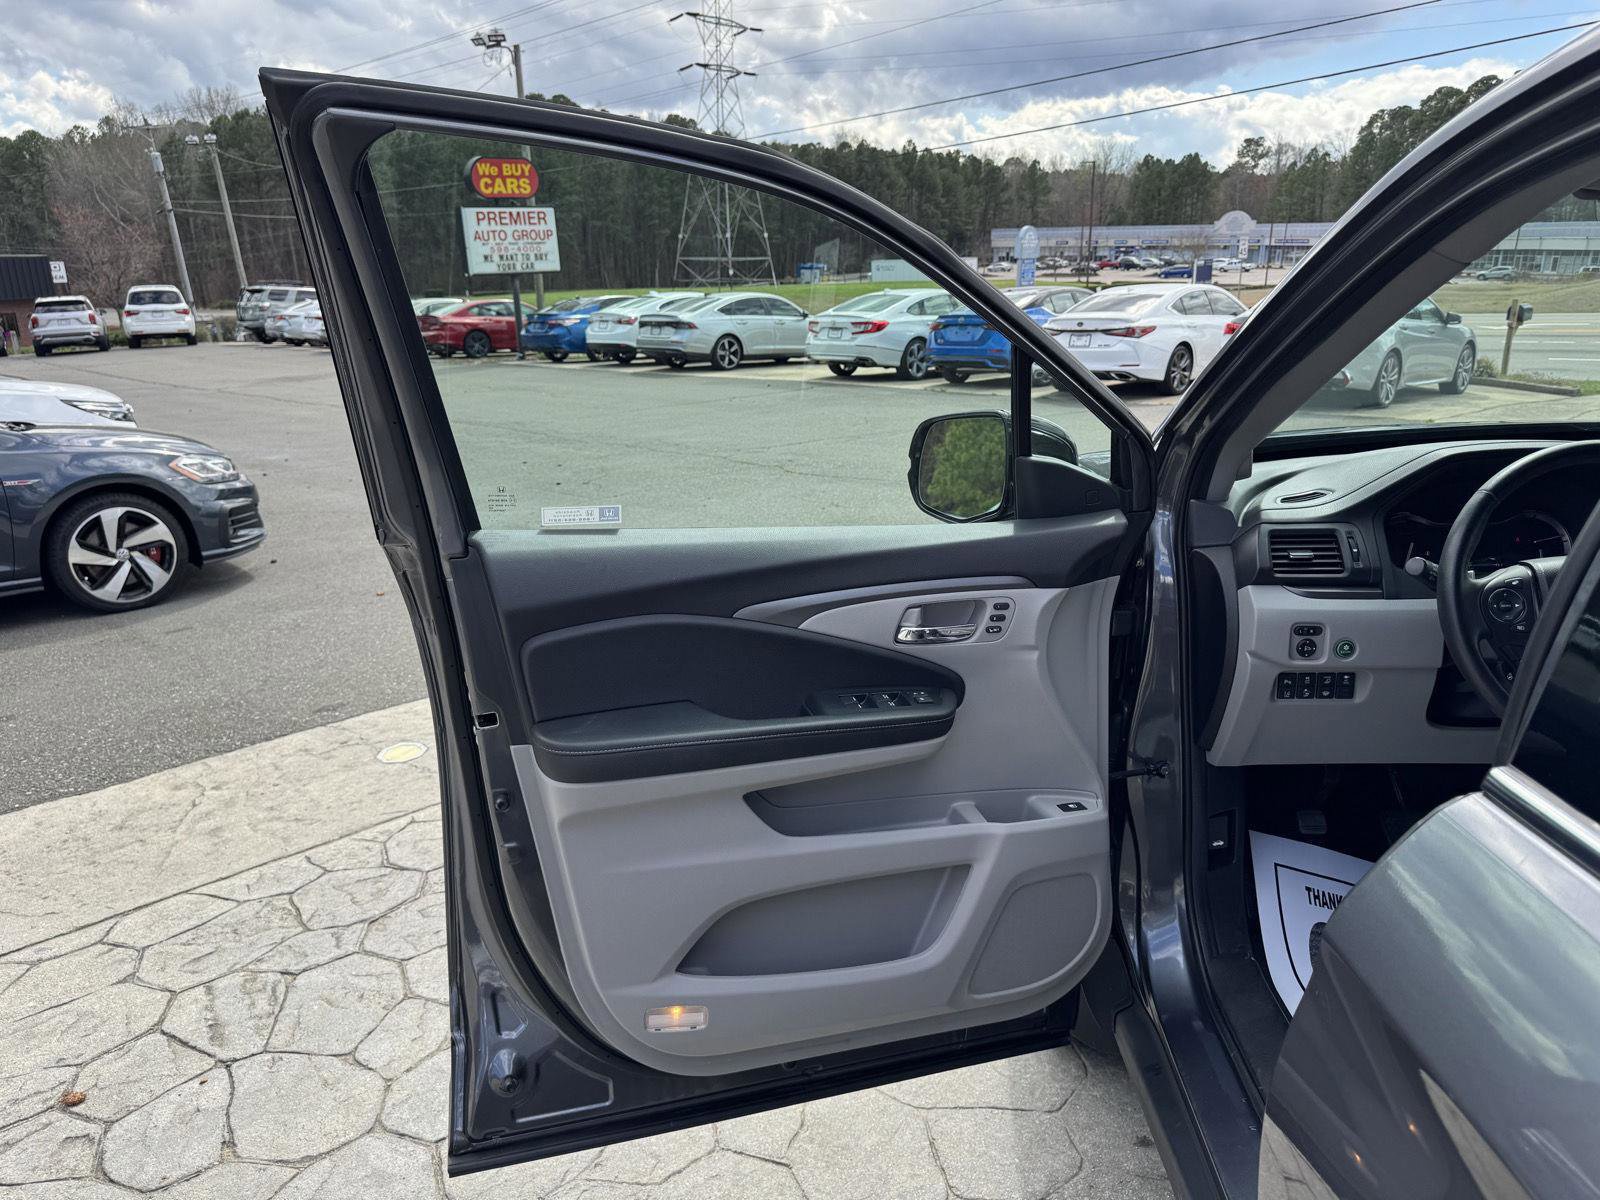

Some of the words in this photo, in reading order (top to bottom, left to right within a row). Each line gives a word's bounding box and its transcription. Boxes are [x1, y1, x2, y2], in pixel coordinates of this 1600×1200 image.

[477, 163, 498, 176] We
[502, 163, 531, 176] BUY
[480, 178, 531, 194] CARS
[476, 211, 548, 226] PREMIER
[474, 230, 508, 242] AUTO
[512, 229, 553, 241] GROUP
[483, 254, 494, 263] WE
[499, 253, 520, 262] WANT
[521, 253, 531, 262] TO
[534, 252, 548, 261] BUY
[497, 263, 517, 271] YOUR
[520, 262, 535, 271] CAR
